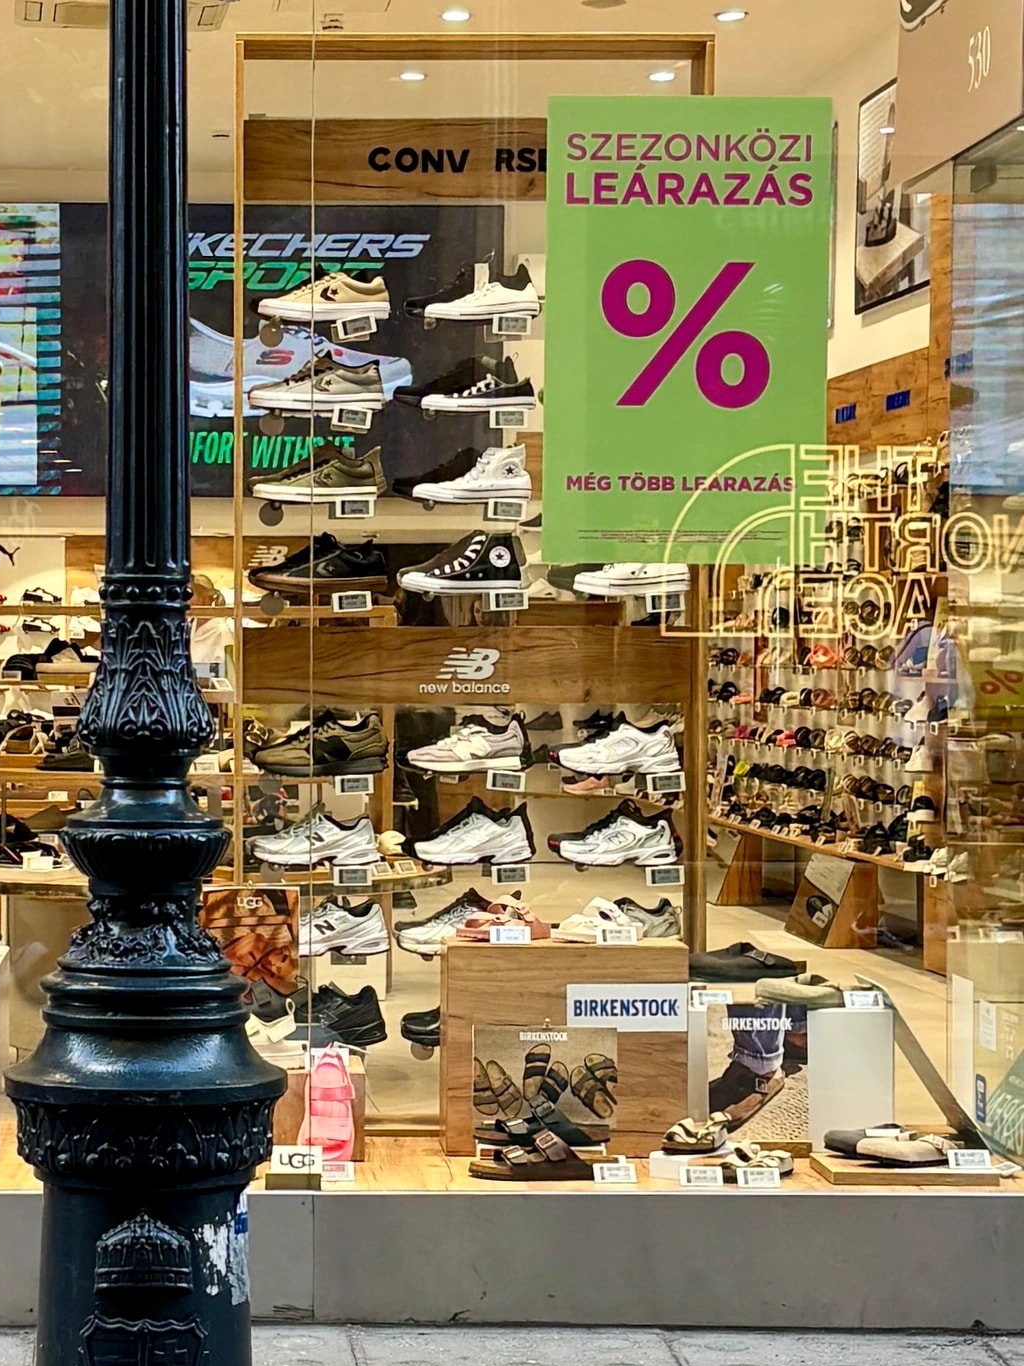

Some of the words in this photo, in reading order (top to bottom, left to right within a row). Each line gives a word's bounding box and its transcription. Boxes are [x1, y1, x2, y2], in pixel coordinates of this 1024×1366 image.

[968, 25, 991, 93] 530
[566, 128, 812, 162] SZEZONKÖZI
[566, 164, 813, 206] LEÁRAZÁS
[188, 232, 431, 259] KECHERS
[600, 259, 771, 409] %
[566, 471, 612, 491] MÉG
[617, 471, 675, 492] TÖBB
[681, 473, 795, 493] LEÁRAZÁS
[419, 683, 448, 693] new
[452, 681, 511, 693] balance
[237, 896, 264, 909] UGG
[573, 999, 679, 1017] BIRKENSTOCK
[722, 1017, 792, 1031] BIRKENSTOCK
[519, 1031, 568, 1042] BIRKENSTOCK
[279, 1153, 316, 1169] UGG
